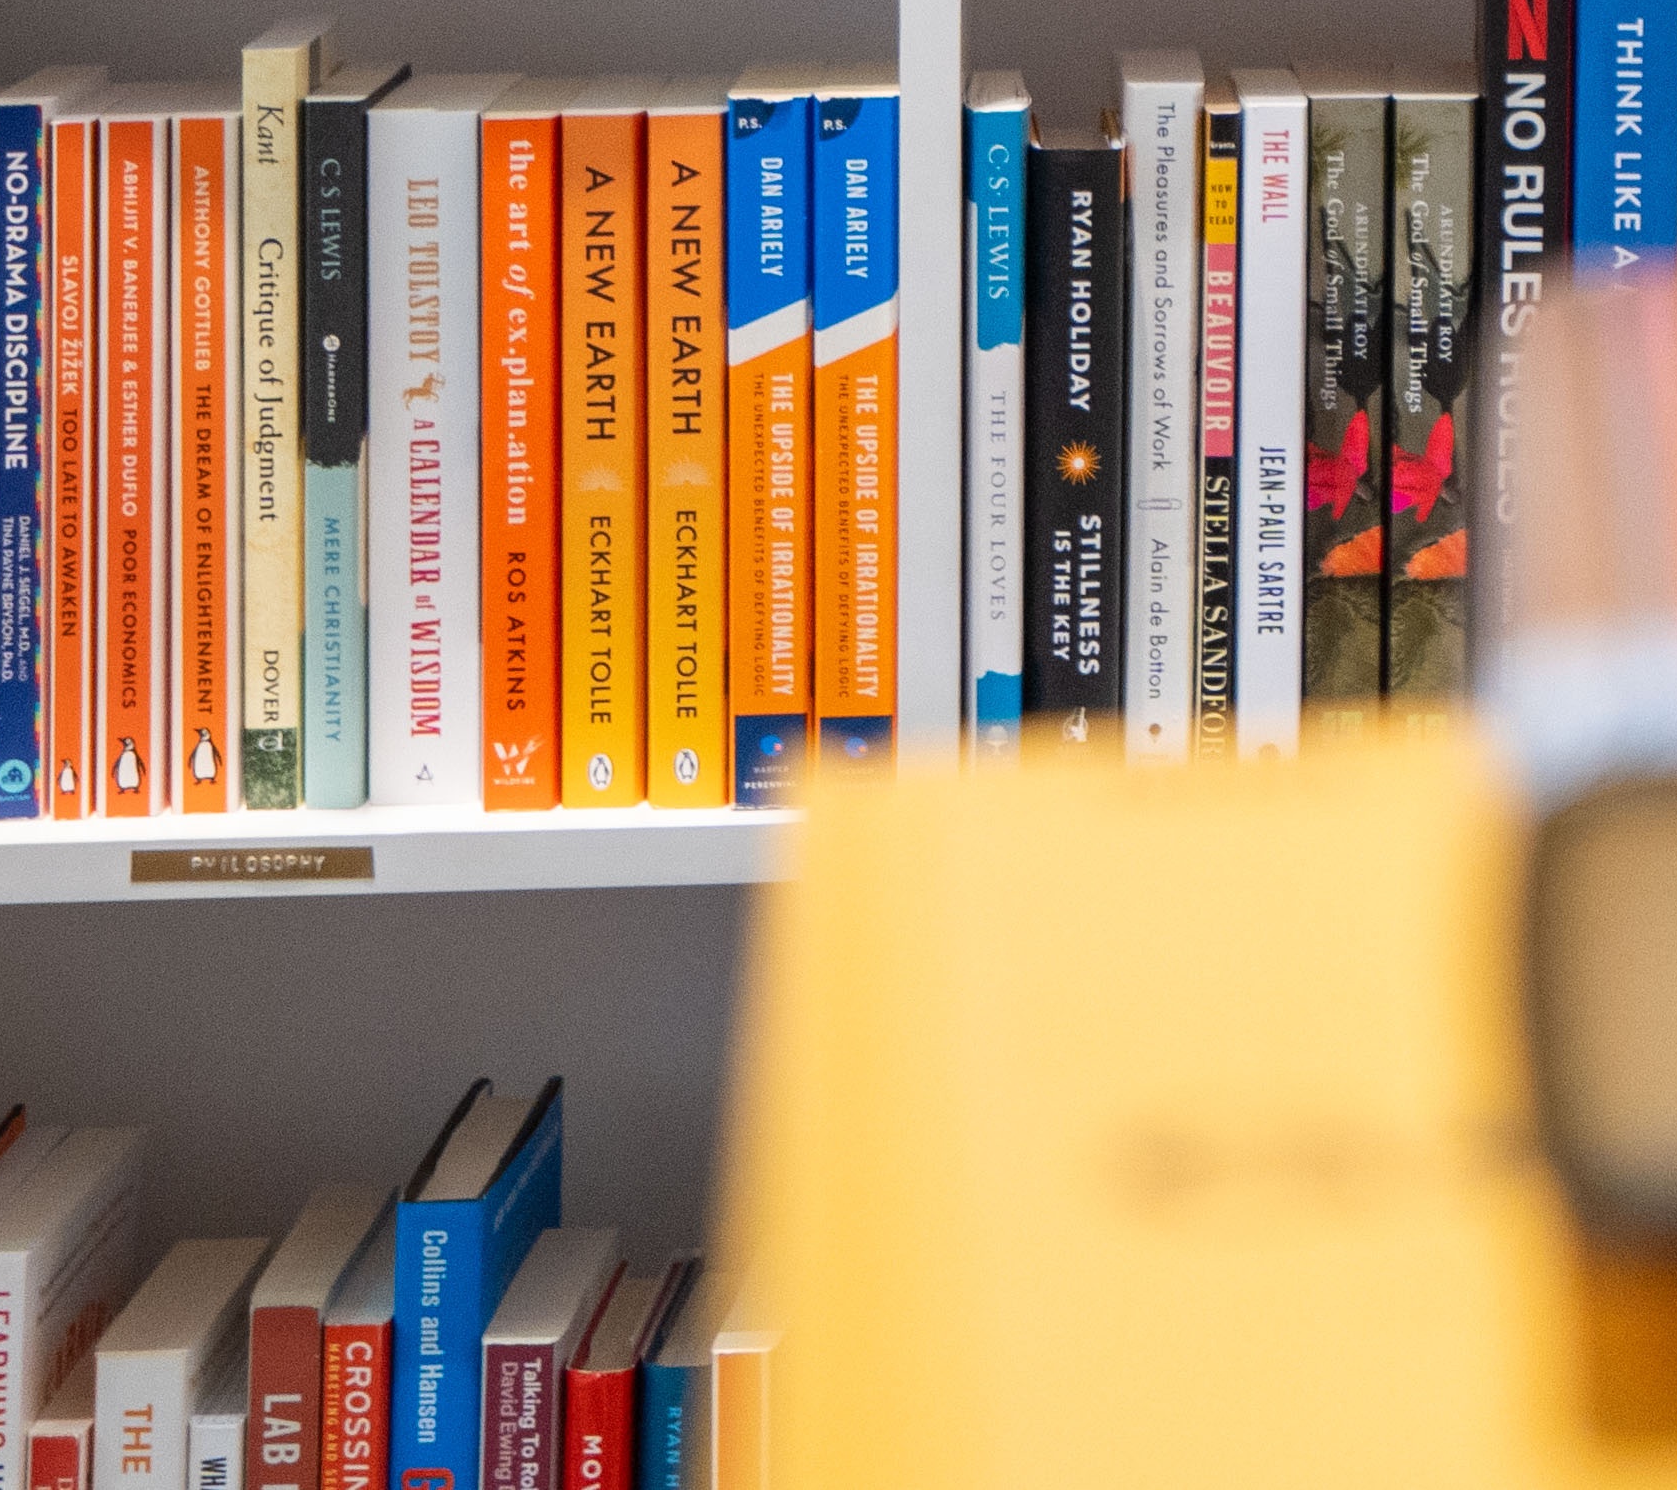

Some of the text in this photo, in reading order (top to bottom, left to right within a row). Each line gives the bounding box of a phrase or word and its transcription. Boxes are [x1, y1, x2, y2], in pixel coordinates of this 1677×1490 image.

[761, 157, 783, 277] DAN ARIELY
[1499, 73, 1547, 338] NO RULES
[1613, 19, 1644, 232] THINK LIKE
[585, 167, 616, 441] A NEW EARTH
[1069, 190, 1093, 413] RYAN HOLIDAY
[590, 516, 612, 724] ECKHART TOLLE
[1053, 530, 1071, 661] IS THE KEY
[1078, 514, 1102, 676] STILLNESS
[263, 1394, 302, 1465] LAB
[417, 1230, 448, 1444] Collins and Hansen
